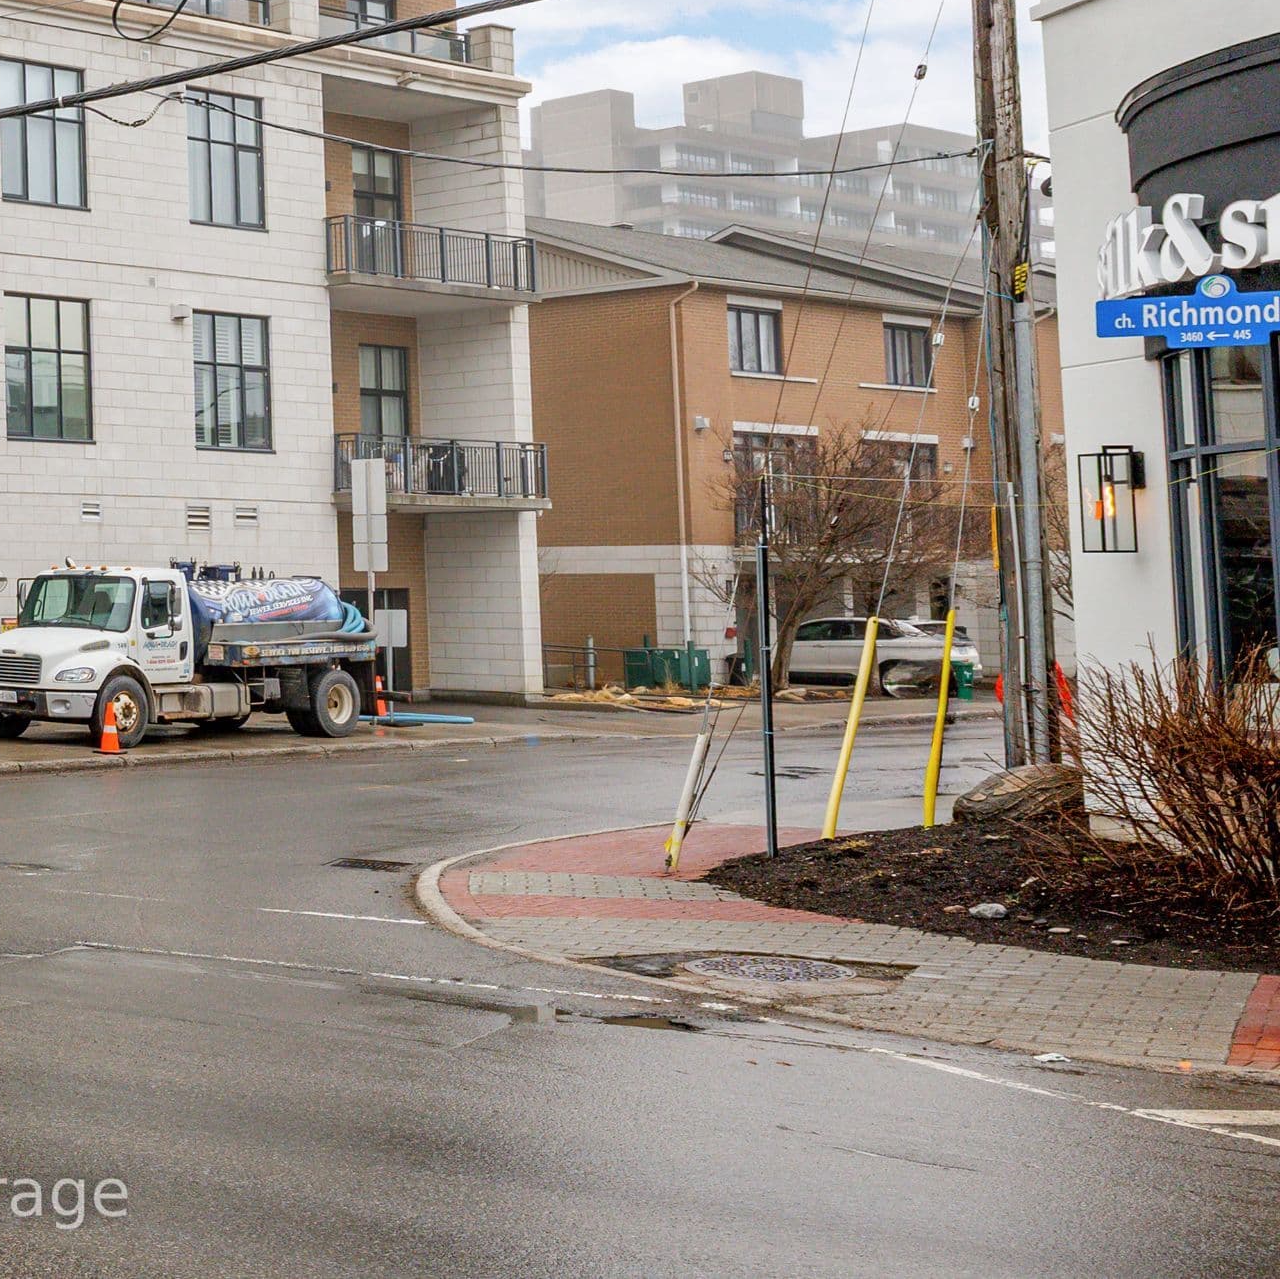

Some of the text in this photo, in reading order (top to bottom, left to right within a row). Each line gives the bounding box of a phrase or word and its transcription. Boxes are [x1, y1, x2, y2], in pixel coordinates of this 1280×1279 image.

[1114, 297, 1280, 329] ch. Richmond
[1180, 330, 1252, 343] 3460 445
